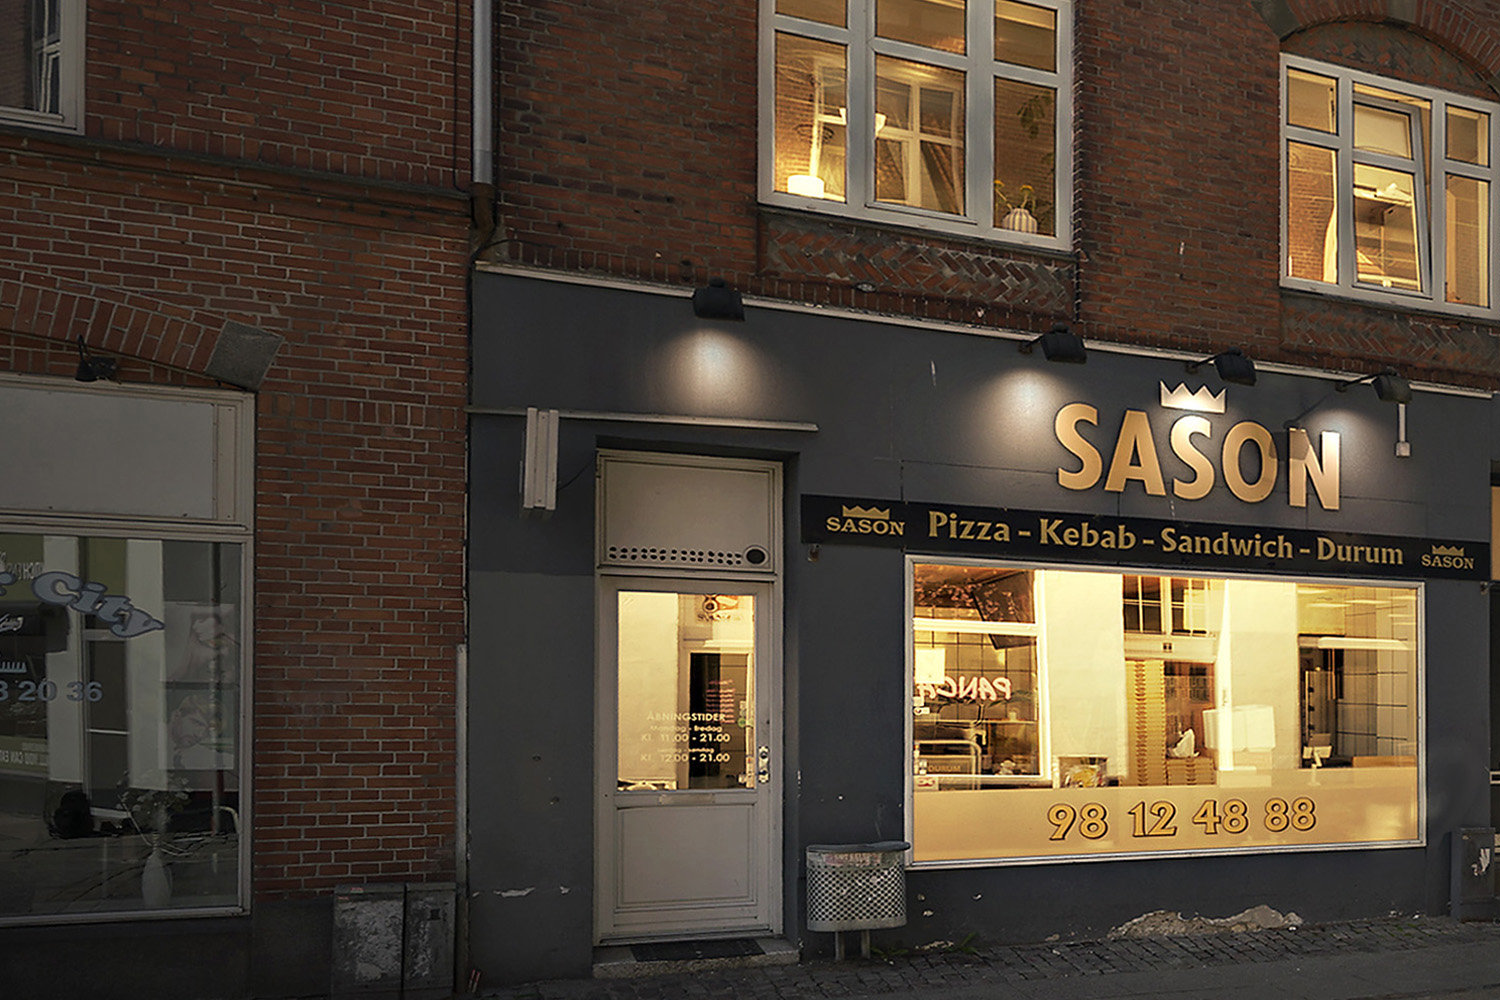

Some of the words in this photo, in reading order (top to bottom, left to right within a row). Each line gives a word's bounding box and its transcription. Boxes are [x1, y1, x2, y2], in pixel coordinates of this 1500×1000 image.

[1054, 402, 1340, 511] SASON
[826, 517, 905, 536] SASON
[929, 510, 1010, 542] Pizza
[1039, 519, 1137, 550] Kebab
[1161, 527, 1293, 559] Sandwich
[1317, 537, 1403, 564] Durum
[1421, 555, 1474, 569] SASON
[32, 571, 164, 637] City
[18, 680, 57, 702] 20
[67, 681, 104, 702] 36
[700, 733, 731, 743] 21.00
[700, 753, 731, 763] 21.00
[1047, 803, 1108, 840] 98
[1128, 801, 1177, 837] 12
[1193, 799, 1249, 834] 48
[1264, 796, 1316, 832] 88
